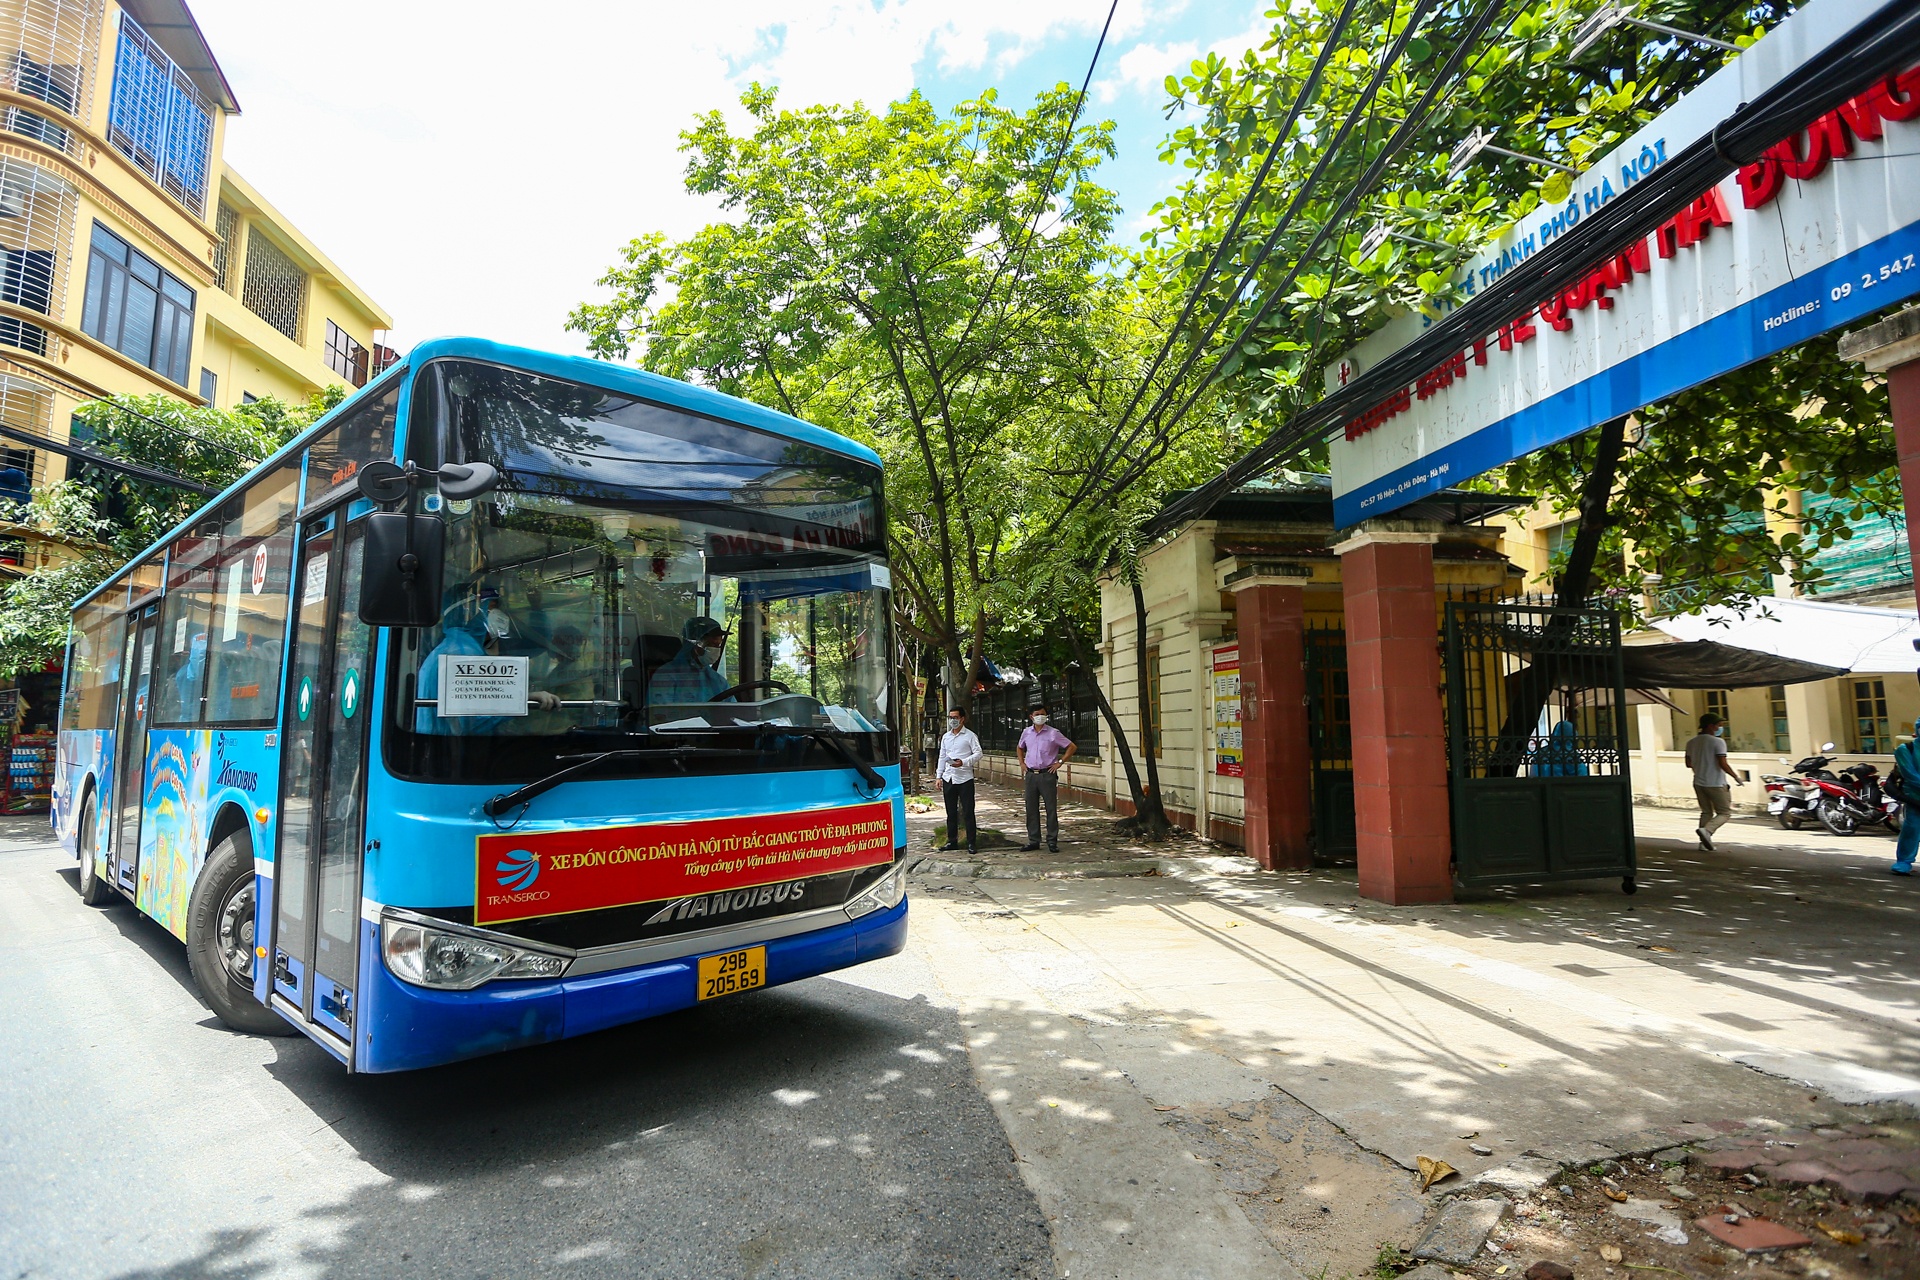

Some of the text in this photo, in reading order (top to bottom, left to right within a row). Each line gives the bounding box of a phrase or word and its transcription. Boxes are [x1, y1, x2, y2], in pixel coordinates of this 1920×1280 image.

[1479, 232, 1536, 287] THÀNH
[1539, 193, 1581, 246] PHỐ
[1583, 175, 1616, 214] HÀ
[1763, 299, 1821, 332] Hotline:
[253, 552, 265, 585] 02
[455, 662, 518, 676] XE SỐ 07:
[216, 759, 258, 792] HANOIBUS
[549, 819, 888, 871] XE ĐÓN CÔNG DÂN HÀ NỘI TỪ BẮC GIANG TRỞ VỀ ĐỊA PHƯƠNG
[684, 860, 710, 877] Tổng
[711, 858, 735, 874] công
[735, 858, 746, 872] ty
[747, 854, 764, 870] Vận
[765, 852, 777, 865] tải
[777, 849, 790, 863] Hà
[791, 847, 807, 863] Nội
[806, 847, 831, 859] chung
[831, 845, 844, 858] tay
[867, 836, 889, 849] COVID
[486, 890, 551, 906] TRANSERCO
[641, 881, 806, 927] HANOIBUS
[718, 951, 748, 975] 29B
[706, 968, 760, 998] 205.69
